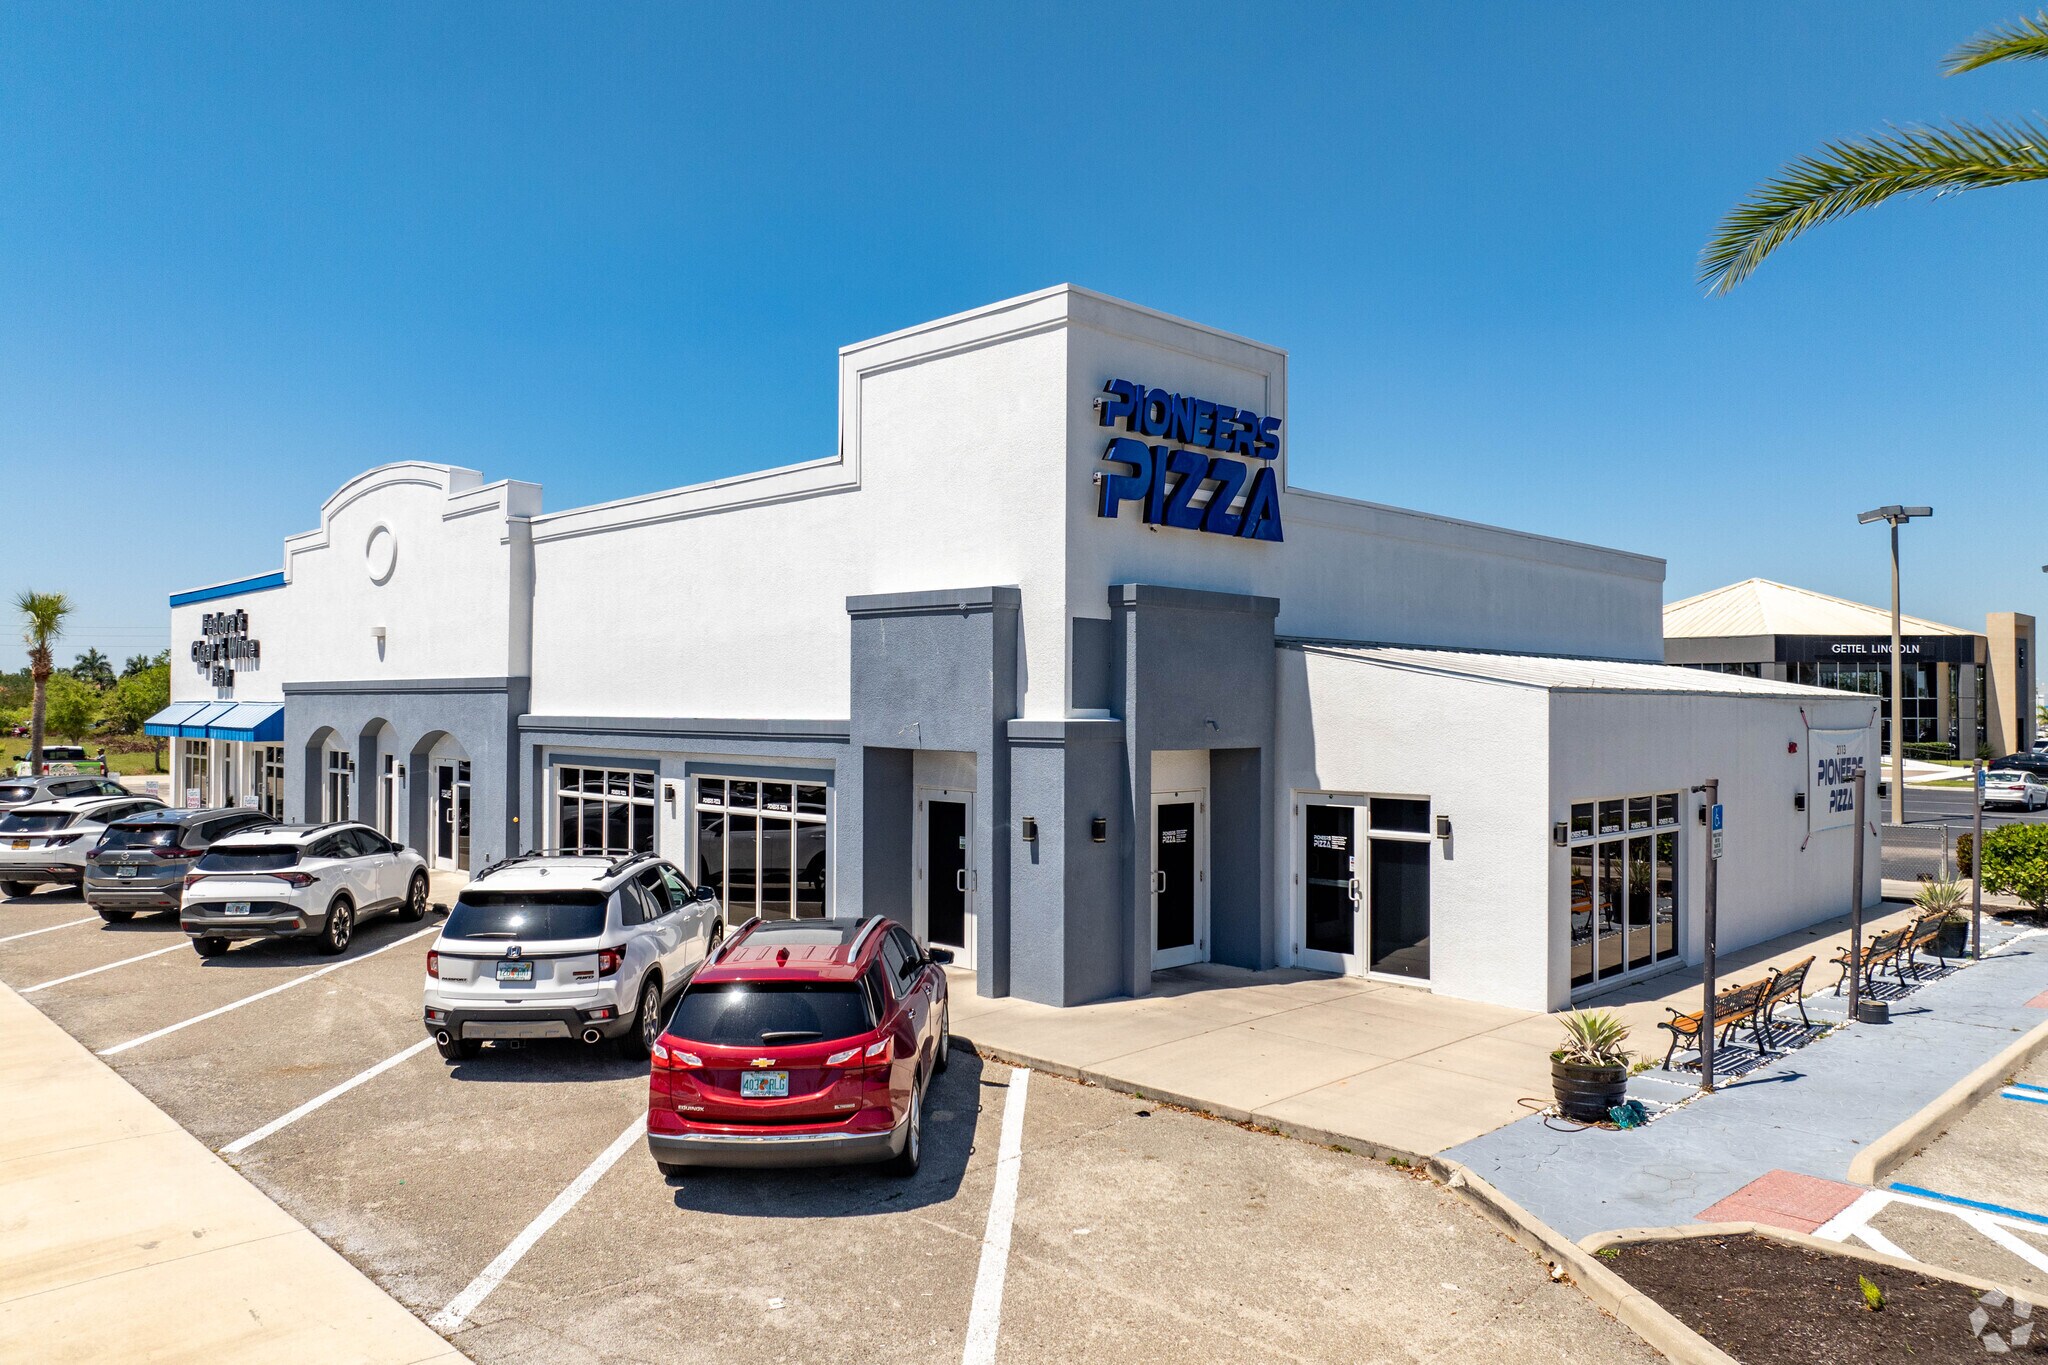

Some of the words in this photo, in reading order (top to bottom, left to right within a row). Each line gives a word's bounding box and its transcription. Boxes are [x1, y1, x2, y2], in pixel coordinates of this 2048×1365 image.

[1099, 378, 1282, 460] PIONEERS
[1098, 437, 1284, 542] PIZZA
[228, 635, 260, 660] Wine
[1831, 644, 1867, 654] GETTEL
[212, 665, 235, 688] Bar
[1829, 788, 1854, 814] PIZZA
[1313, 840, 1332, 848] PIZZA
[743, 1079, 760, 1091] 403
[768, 1079, 785, 1091] RLG
[677, 1104, 705, 1112] EQUINOX
